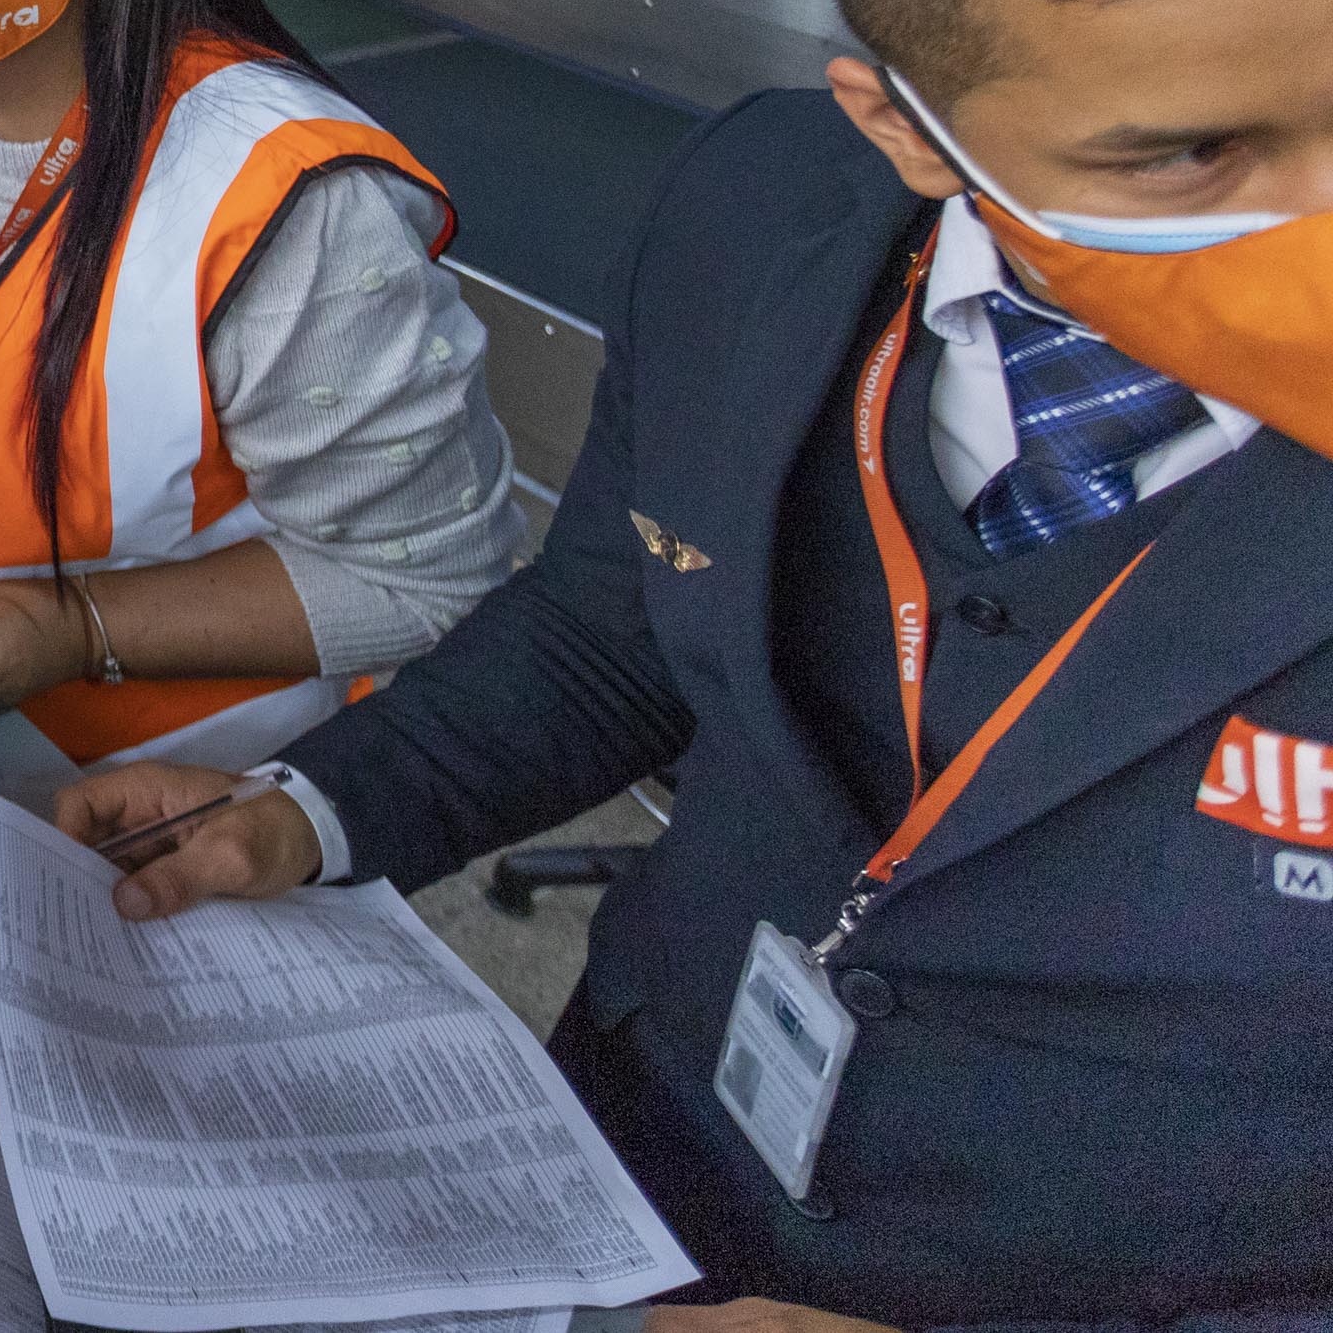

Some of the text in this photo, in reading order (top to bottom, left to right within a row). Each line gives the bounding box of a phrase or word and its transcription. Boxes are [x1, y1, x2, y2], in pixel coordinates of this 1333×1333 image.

[40, 137, 78, 186] ultra
[858, 332, 897, 454] ultraair.com
[899, 602, 917, 682] ultra
